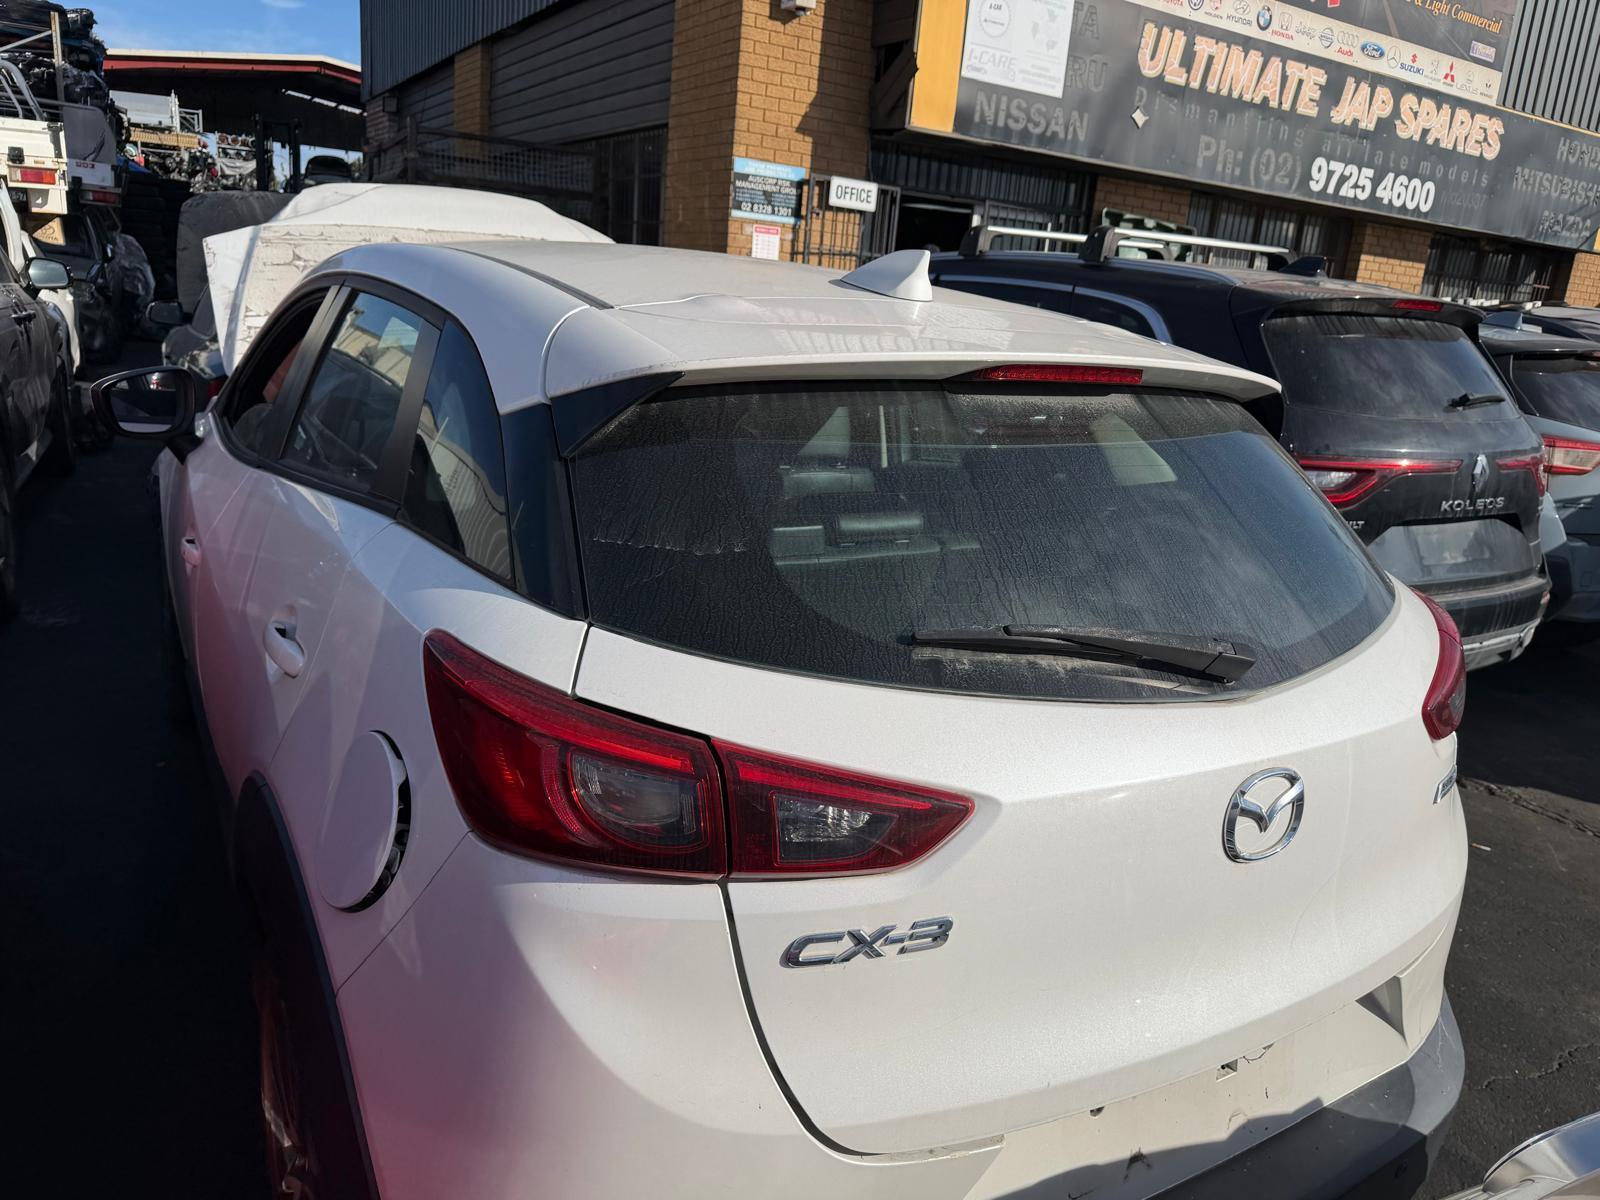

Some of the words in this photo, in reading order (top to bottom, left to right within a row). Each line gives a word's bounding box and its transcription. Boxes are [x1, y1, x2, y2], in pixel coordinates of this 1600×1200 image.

[1226, 14, 1253, 27] HYUNDAI
[1425, 0, 1450, 15] Light
[1451, 4, 1502, 33] Commercial
[1272, 29, 1294, 41] HONDA
[1363, 43, 1382, 58] Ford
[1400, 62, 1425, 76] SUZUKI
[1137, 22, 1328, 118] ULTIMATE
[1330, 76, 1393, 132] JAP
[1395, 92, 1504, 161] SPARES
[973, 90, 1089, 142] NISSAN
[1195, 134, 1245, 177] Ph:
[1250, 146, 1302, 194] (02)
[1309, 156, 1374, 200] 9725
[1375, 172, 1436, 213] 4600
[1418, 158, 1489, 188] models
[736, 180, 780, 193] MANAGEMENT
[836, 184, 873, 204] OFFICE
[741, 202, 752, 212] 02
[1440, 496, 1506, 512] KOLEOS
[780, 915, 954, 969] CX-3
